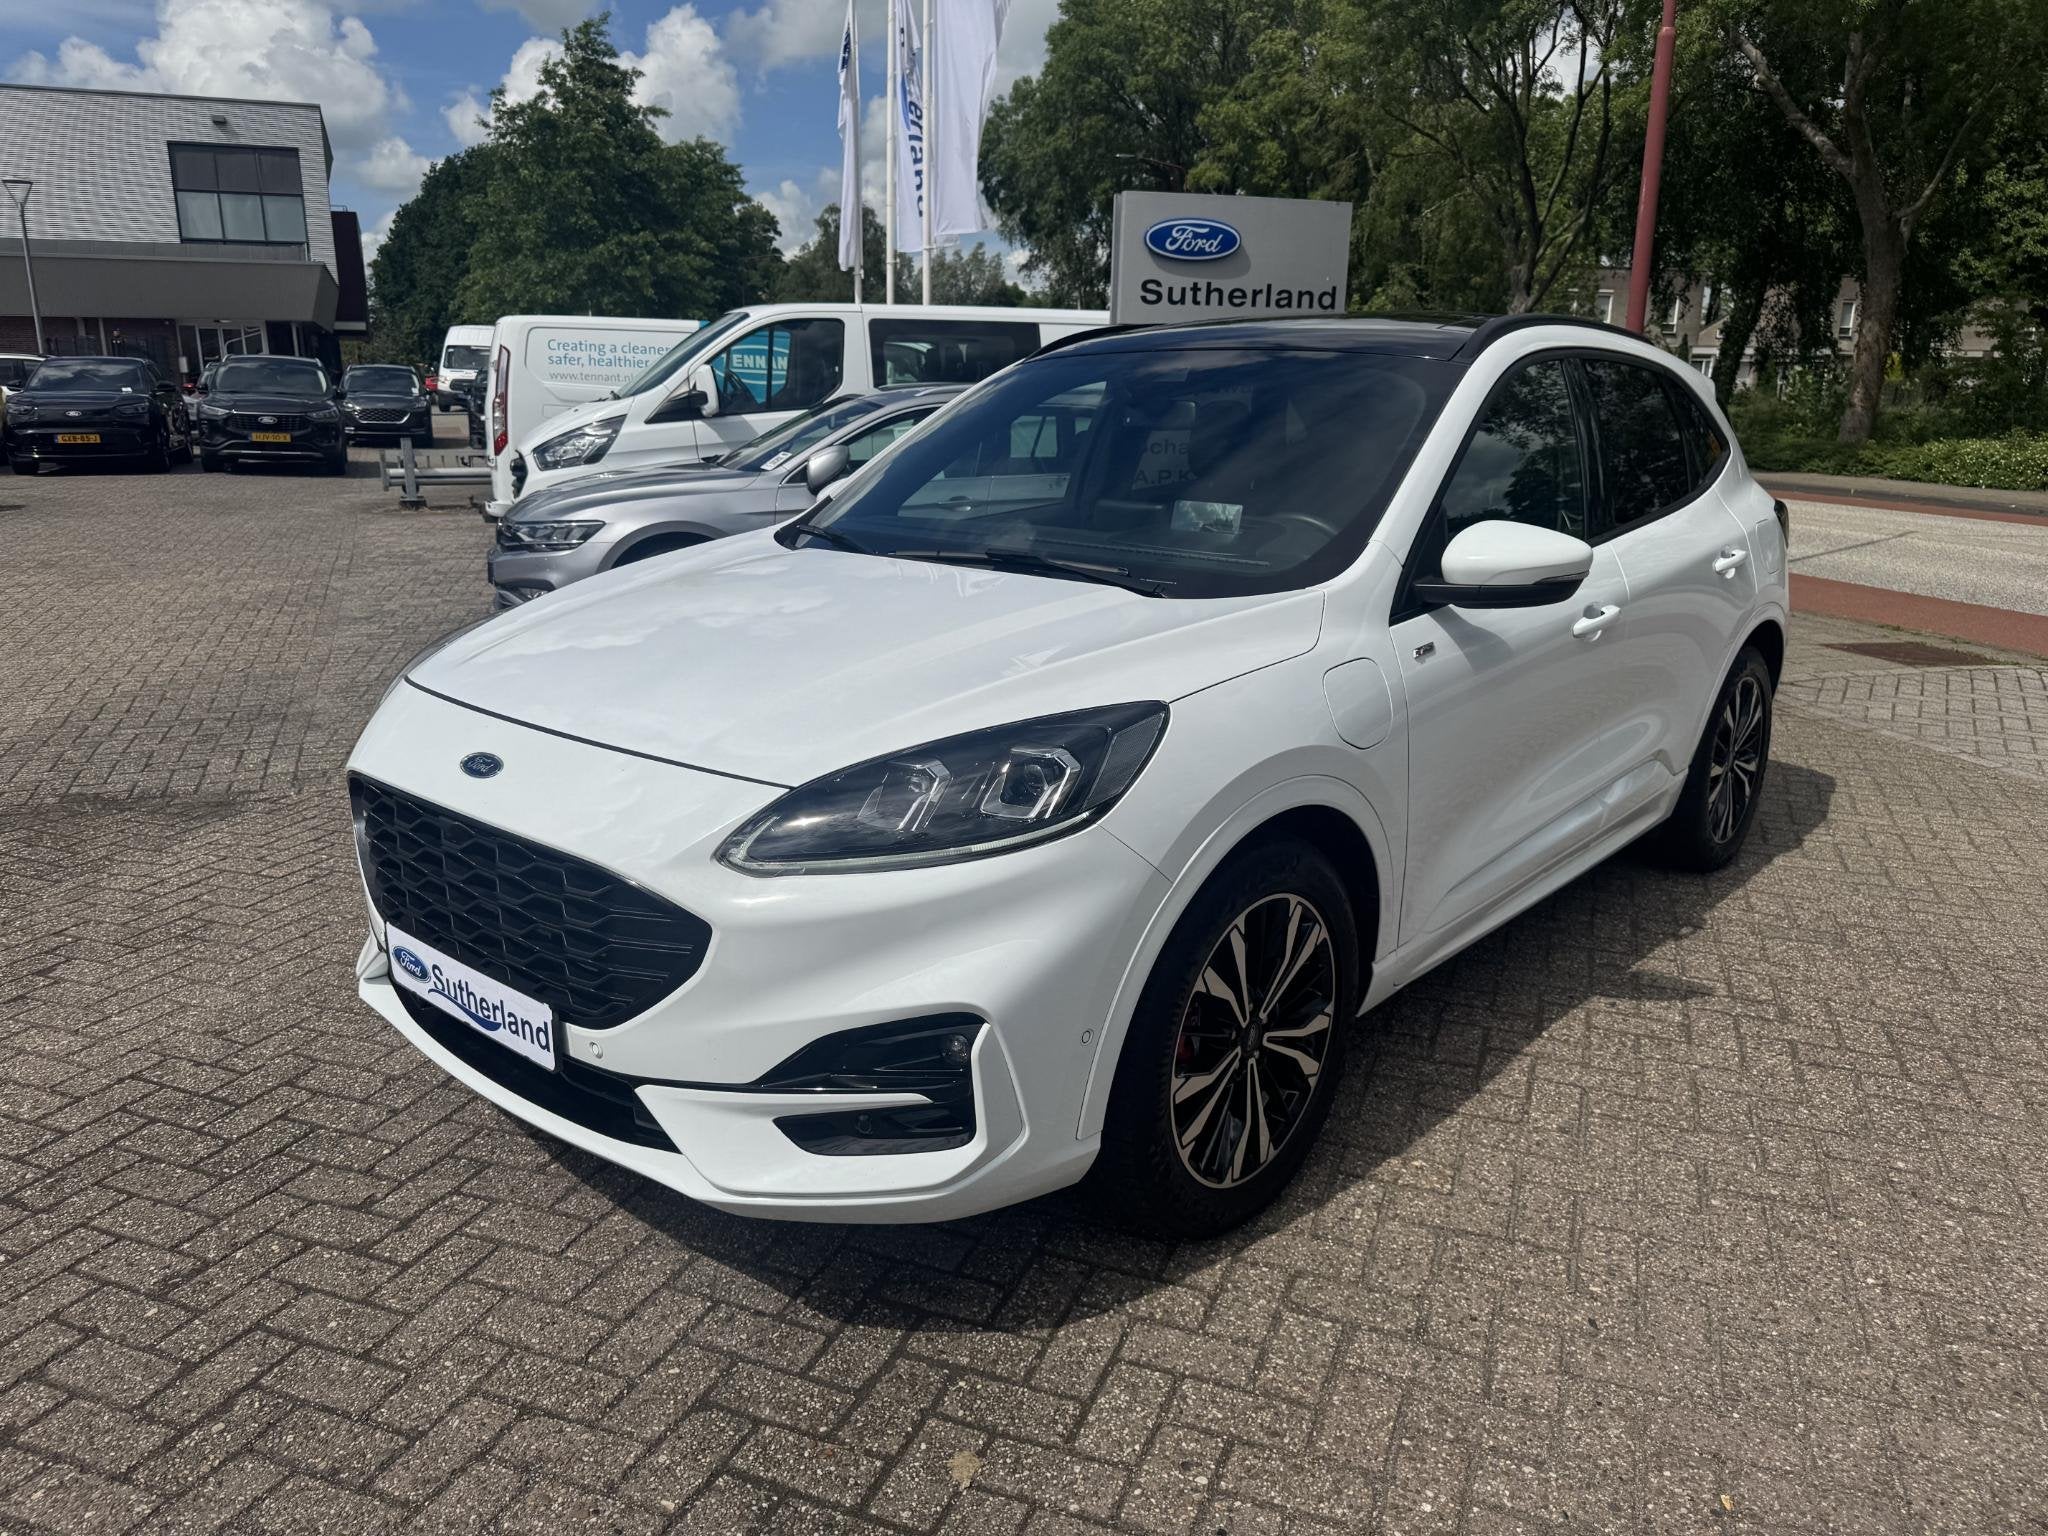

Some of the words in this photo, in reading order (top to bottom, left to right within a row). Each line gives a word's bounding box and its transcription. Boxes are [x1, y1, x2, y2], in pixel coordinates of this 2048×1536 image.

[1165, 225, 1223, 253] Ford
[1140, 279, 1337, 310] Sutherland
[547, 339, 605, 354] Creating
[609, 345, 617, 353] a
[547, 355, 585, 368] safer,
[588, 356, 650, 369] healthier
[400, 951, 422, 977] Ford
[431, 964, 551, 1053] Sutherland
